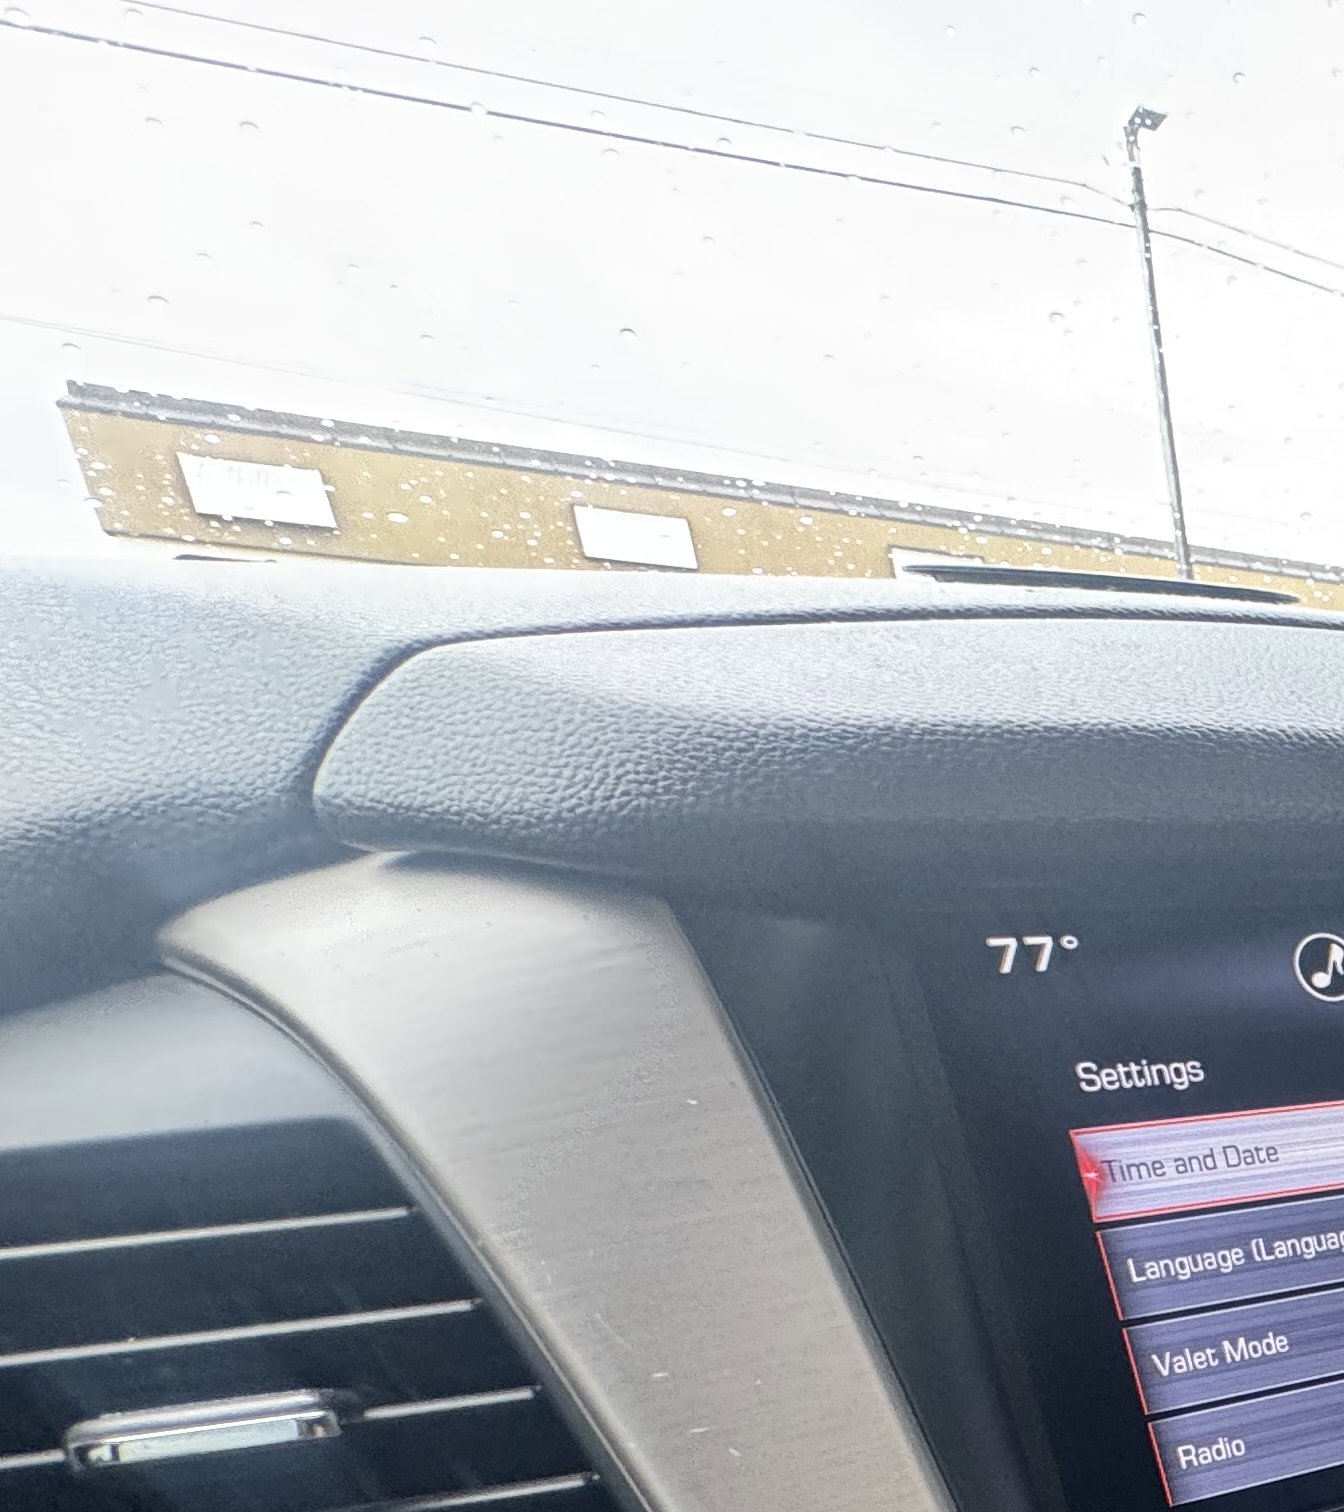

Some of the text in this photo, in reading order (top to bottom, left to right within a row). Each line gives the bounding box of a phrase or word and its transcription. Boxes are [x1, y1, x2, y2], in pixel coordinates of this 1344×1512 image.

[1075, 1059, 1205, 1092] Settings
[1104, 1142, 1280, 1184] Time and Date
[1127, 1245, 1245, 1284] Language
[1151, 1331, 1290, 1377] Valet Mode
[1177, 1436, 1246, 1469] Radio
